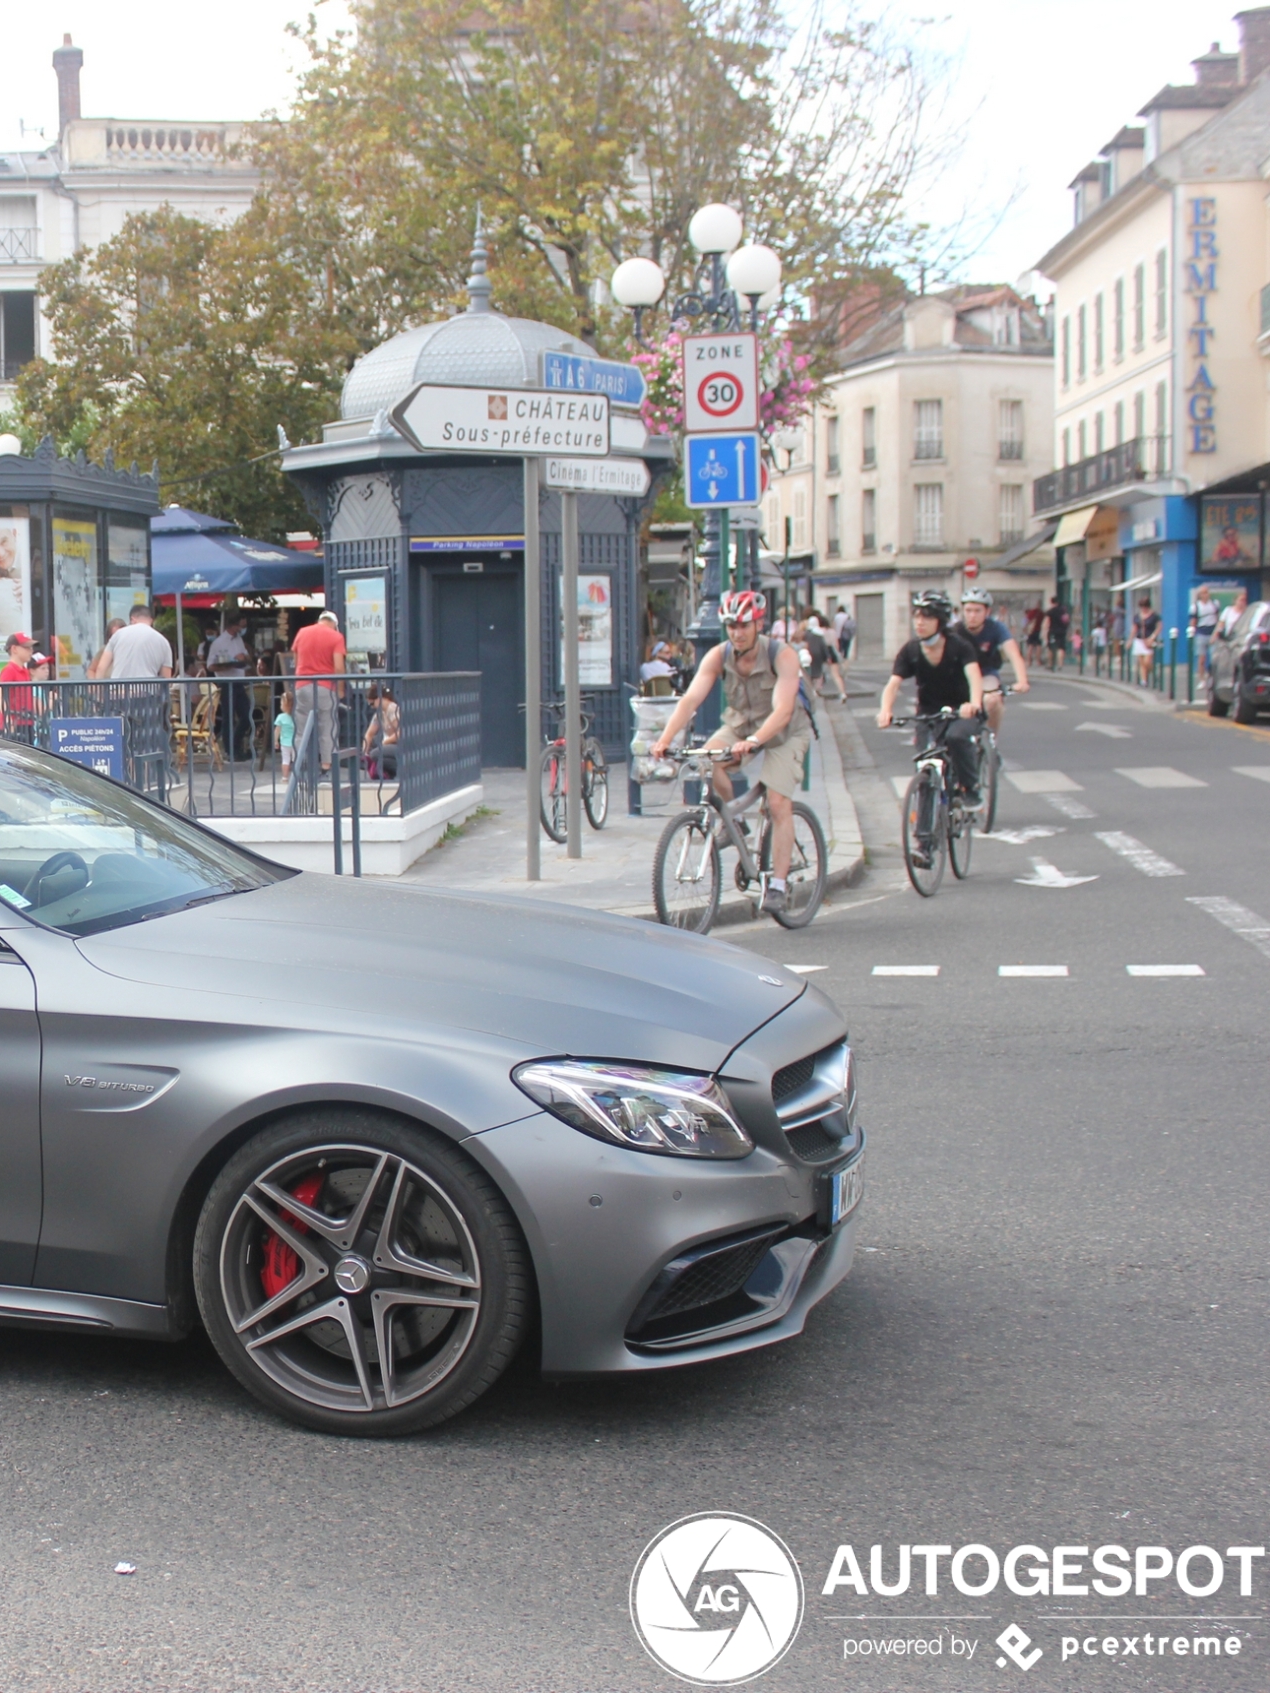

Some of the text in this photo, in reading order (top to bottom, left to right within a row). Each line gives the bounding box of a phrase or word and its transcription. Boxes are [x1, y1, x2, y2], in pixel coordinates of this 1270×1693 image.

[1184, 197, 1220, 456] ERMITAGE
[696, 345, 743, 360] ZONE
[592, 374, 627, 395] (PARIS)
[707, 384, 734, 403] 30
[515, 397, 605, 422] CHÂTEAU
[442, 422, 603, 448] Sous-préfecture
[549, 461, 642, 487] Cinéma l'Ermitage
[432, 541, 464, 549] Parking
[84, 744, 114, 752] PIÉTONS
[64, 1074, 155, 1094] V8 BITURBO
